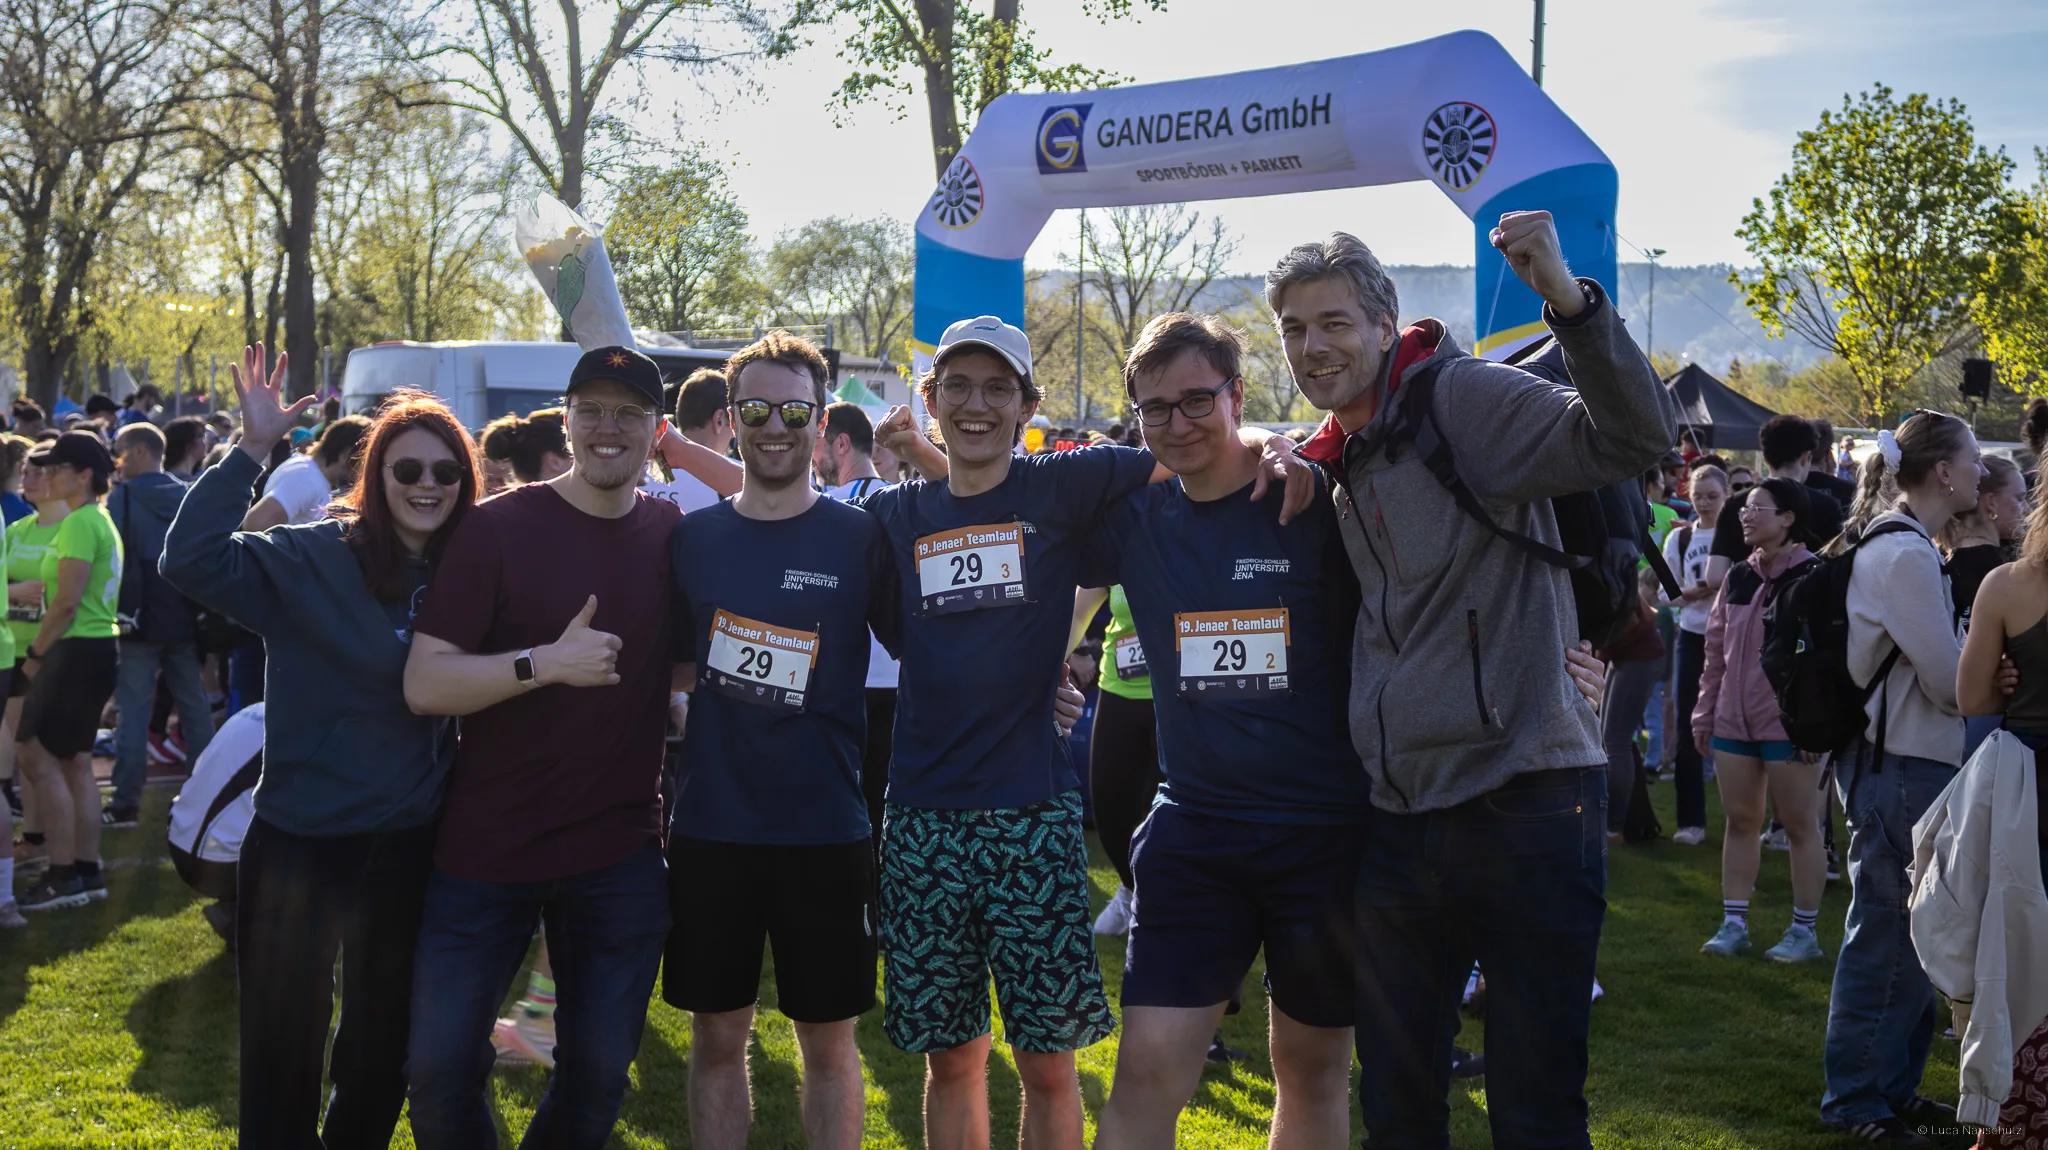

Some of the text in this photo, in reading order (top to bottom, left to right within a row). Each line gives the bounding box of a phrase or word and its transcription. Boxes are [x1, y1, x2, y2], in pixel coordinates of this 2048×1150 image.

[1097, 92, 1332, 148] GANDERA GmbH
[1136, 162, 1228, 183] SPORTBÖDEN
[1241, 155, 1304, 175] PARKETT
[966, 529, 1018, 545] Teamlauf
[950, 553, 983, 586] 29
[1001, 563, 1011, 579] 3
[1231, 571, 1254, 580] JENA
[780, 581, 804, 591] JENA
[1231, 616, 1285, 631] Teamlauf
[765, 630, 815, 651] Teamlauf
[736, 646, 773, 680] 29
[1213, 639, 1247, 672] 29
[1265, 652, 1275, 669] 2
[788, 670, 796, 685] 1
